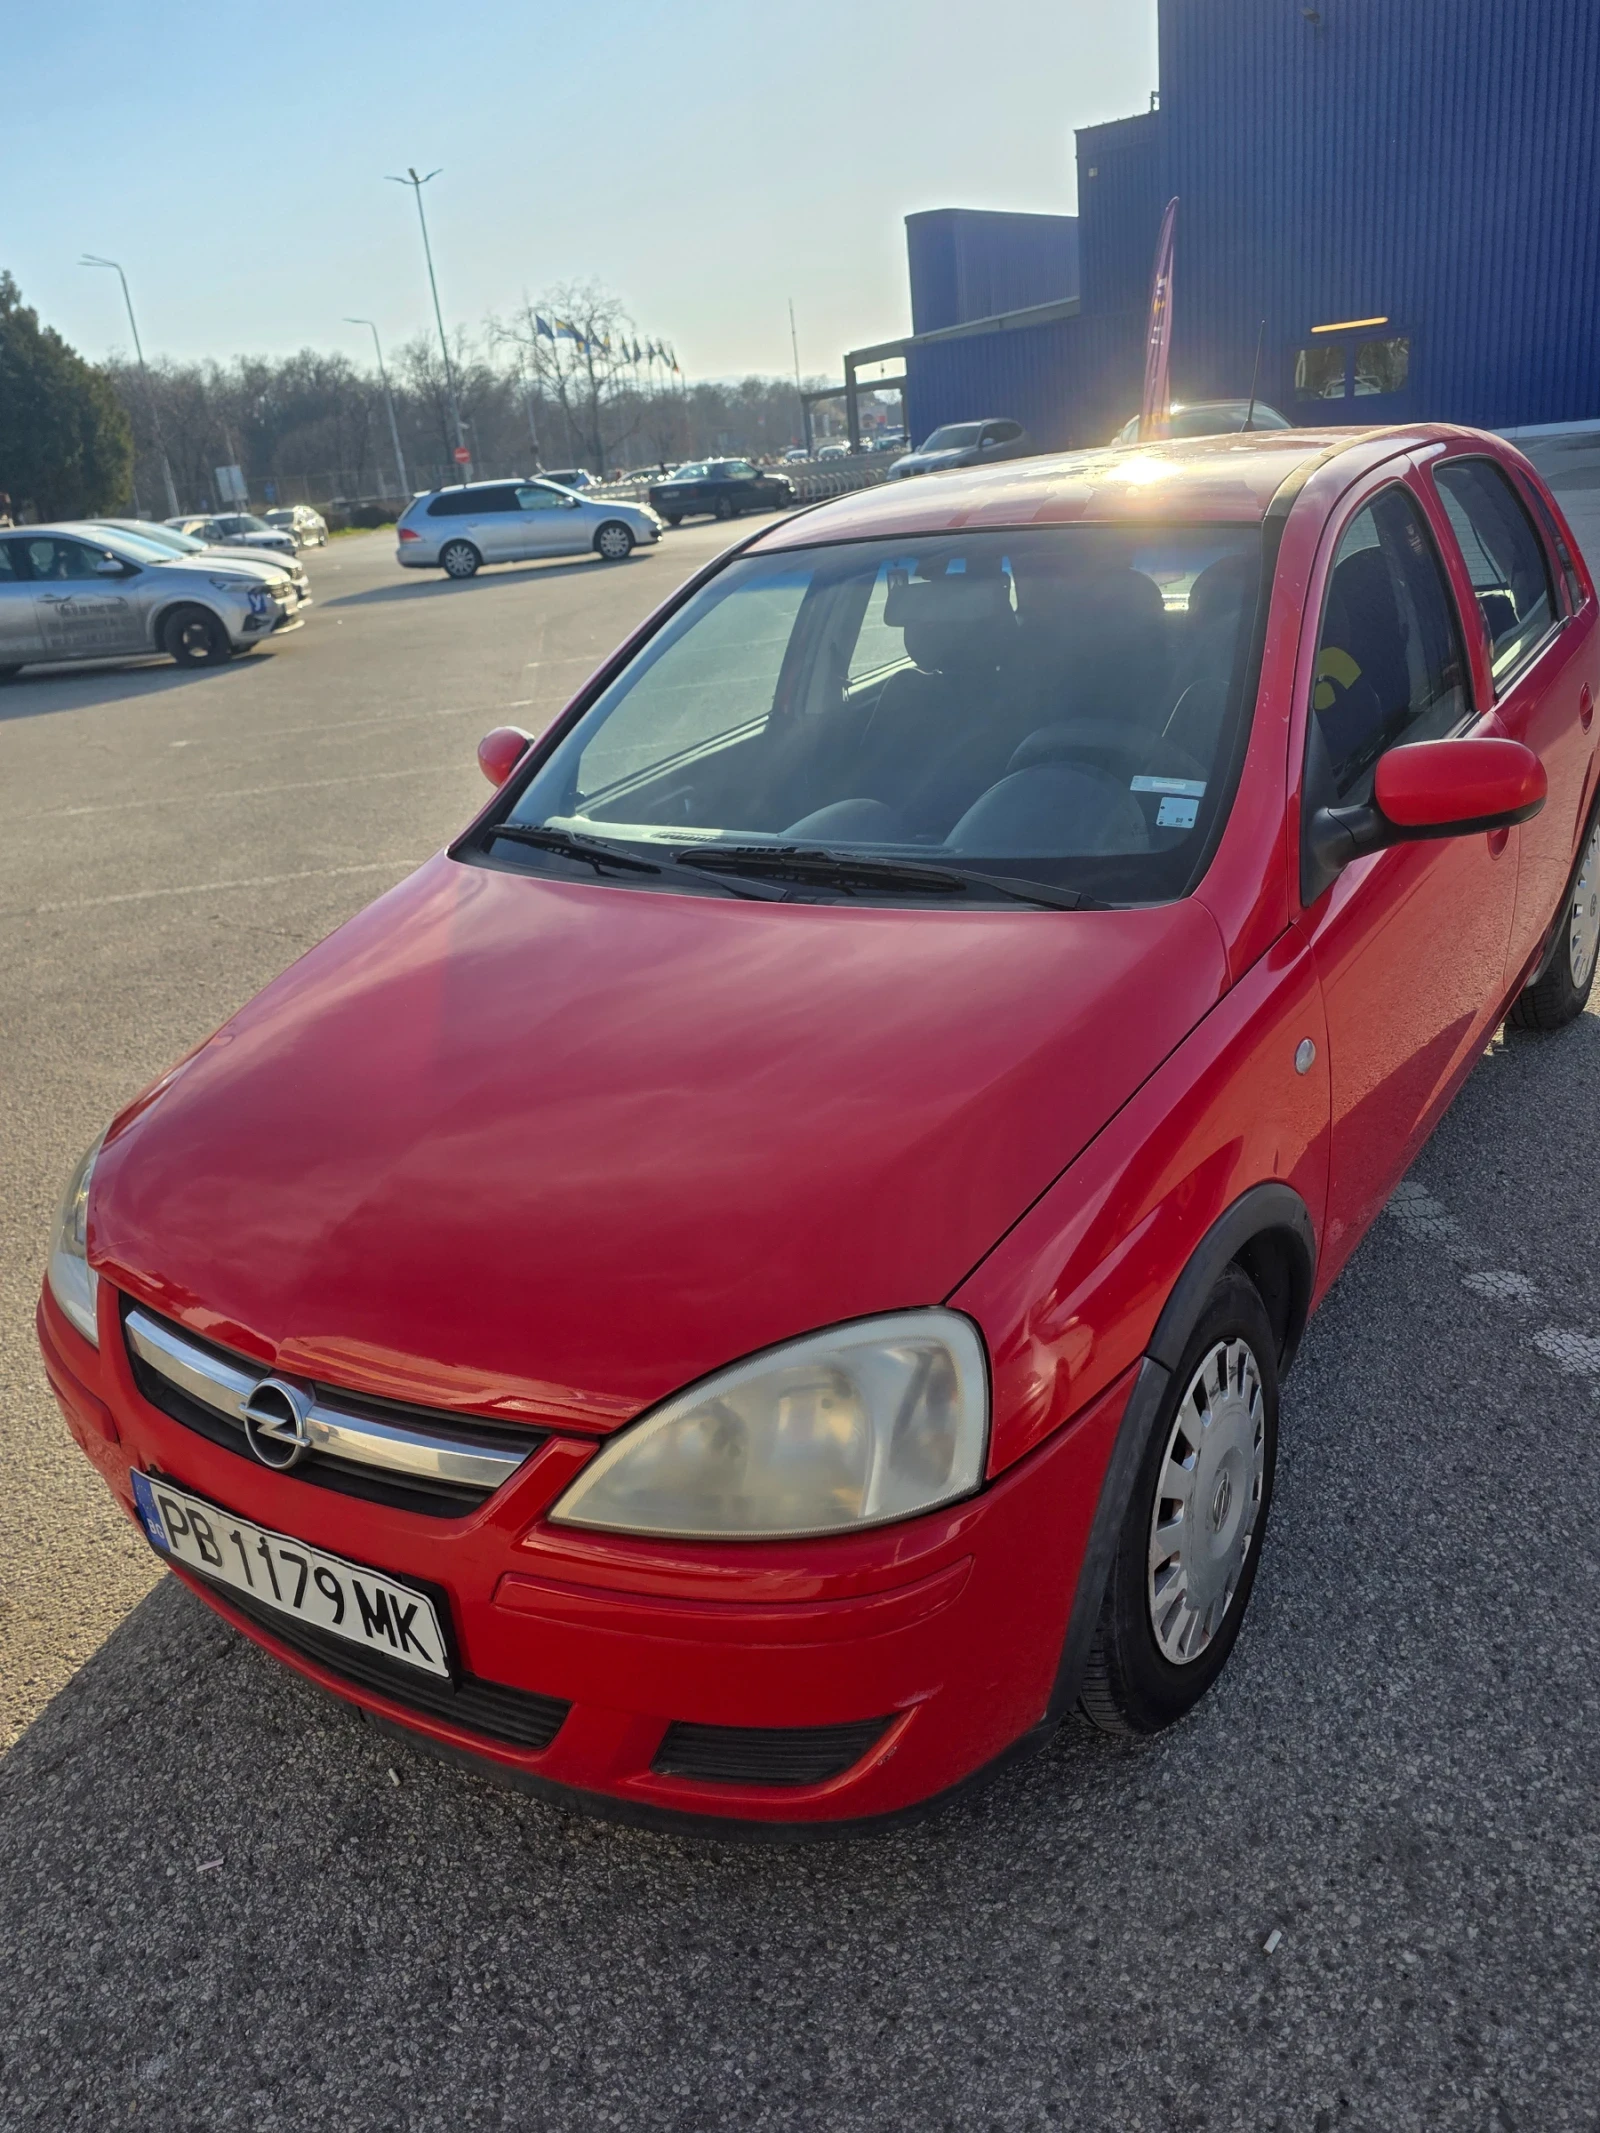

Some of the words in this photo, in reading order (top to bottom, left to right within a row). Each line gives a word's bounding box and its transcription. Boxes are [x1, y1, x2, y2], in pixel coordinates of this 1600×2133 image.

[146, 1517, 165, 1540] BG
[229, 1529, 345, 1625] 1179
[352, 1579, 436, 1664] MK
